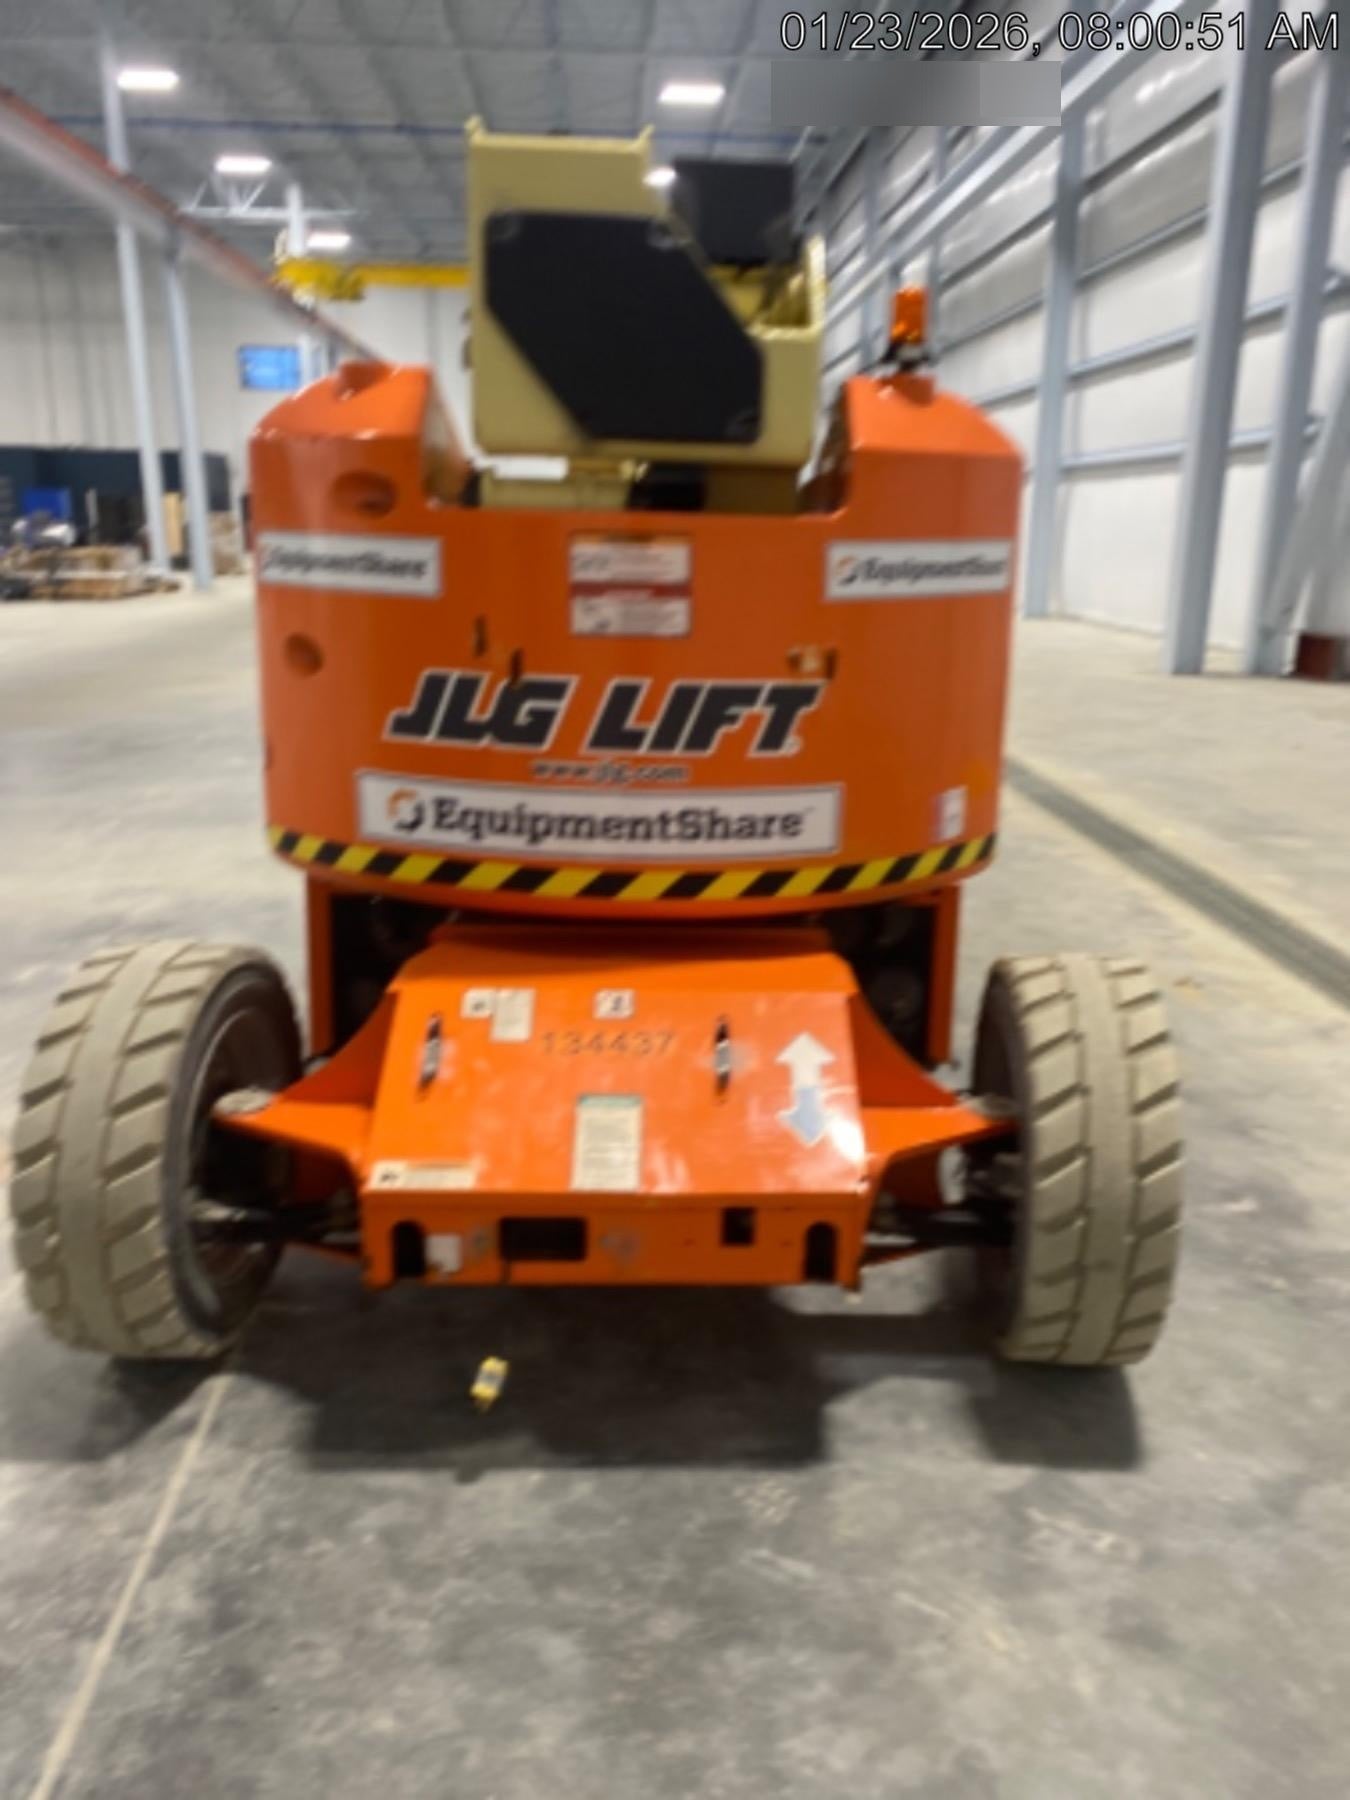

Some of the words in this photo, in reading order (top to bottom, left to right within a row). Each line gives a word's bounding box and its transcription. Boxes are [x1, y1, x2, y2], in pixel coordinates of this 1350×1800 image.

[383, 668, 579, 751] JLG
[581, 677, 828, 758] LIFT
[432, 796, 805, 845] EquipmentShare
[542, 1030, 677, 1057] 134437
